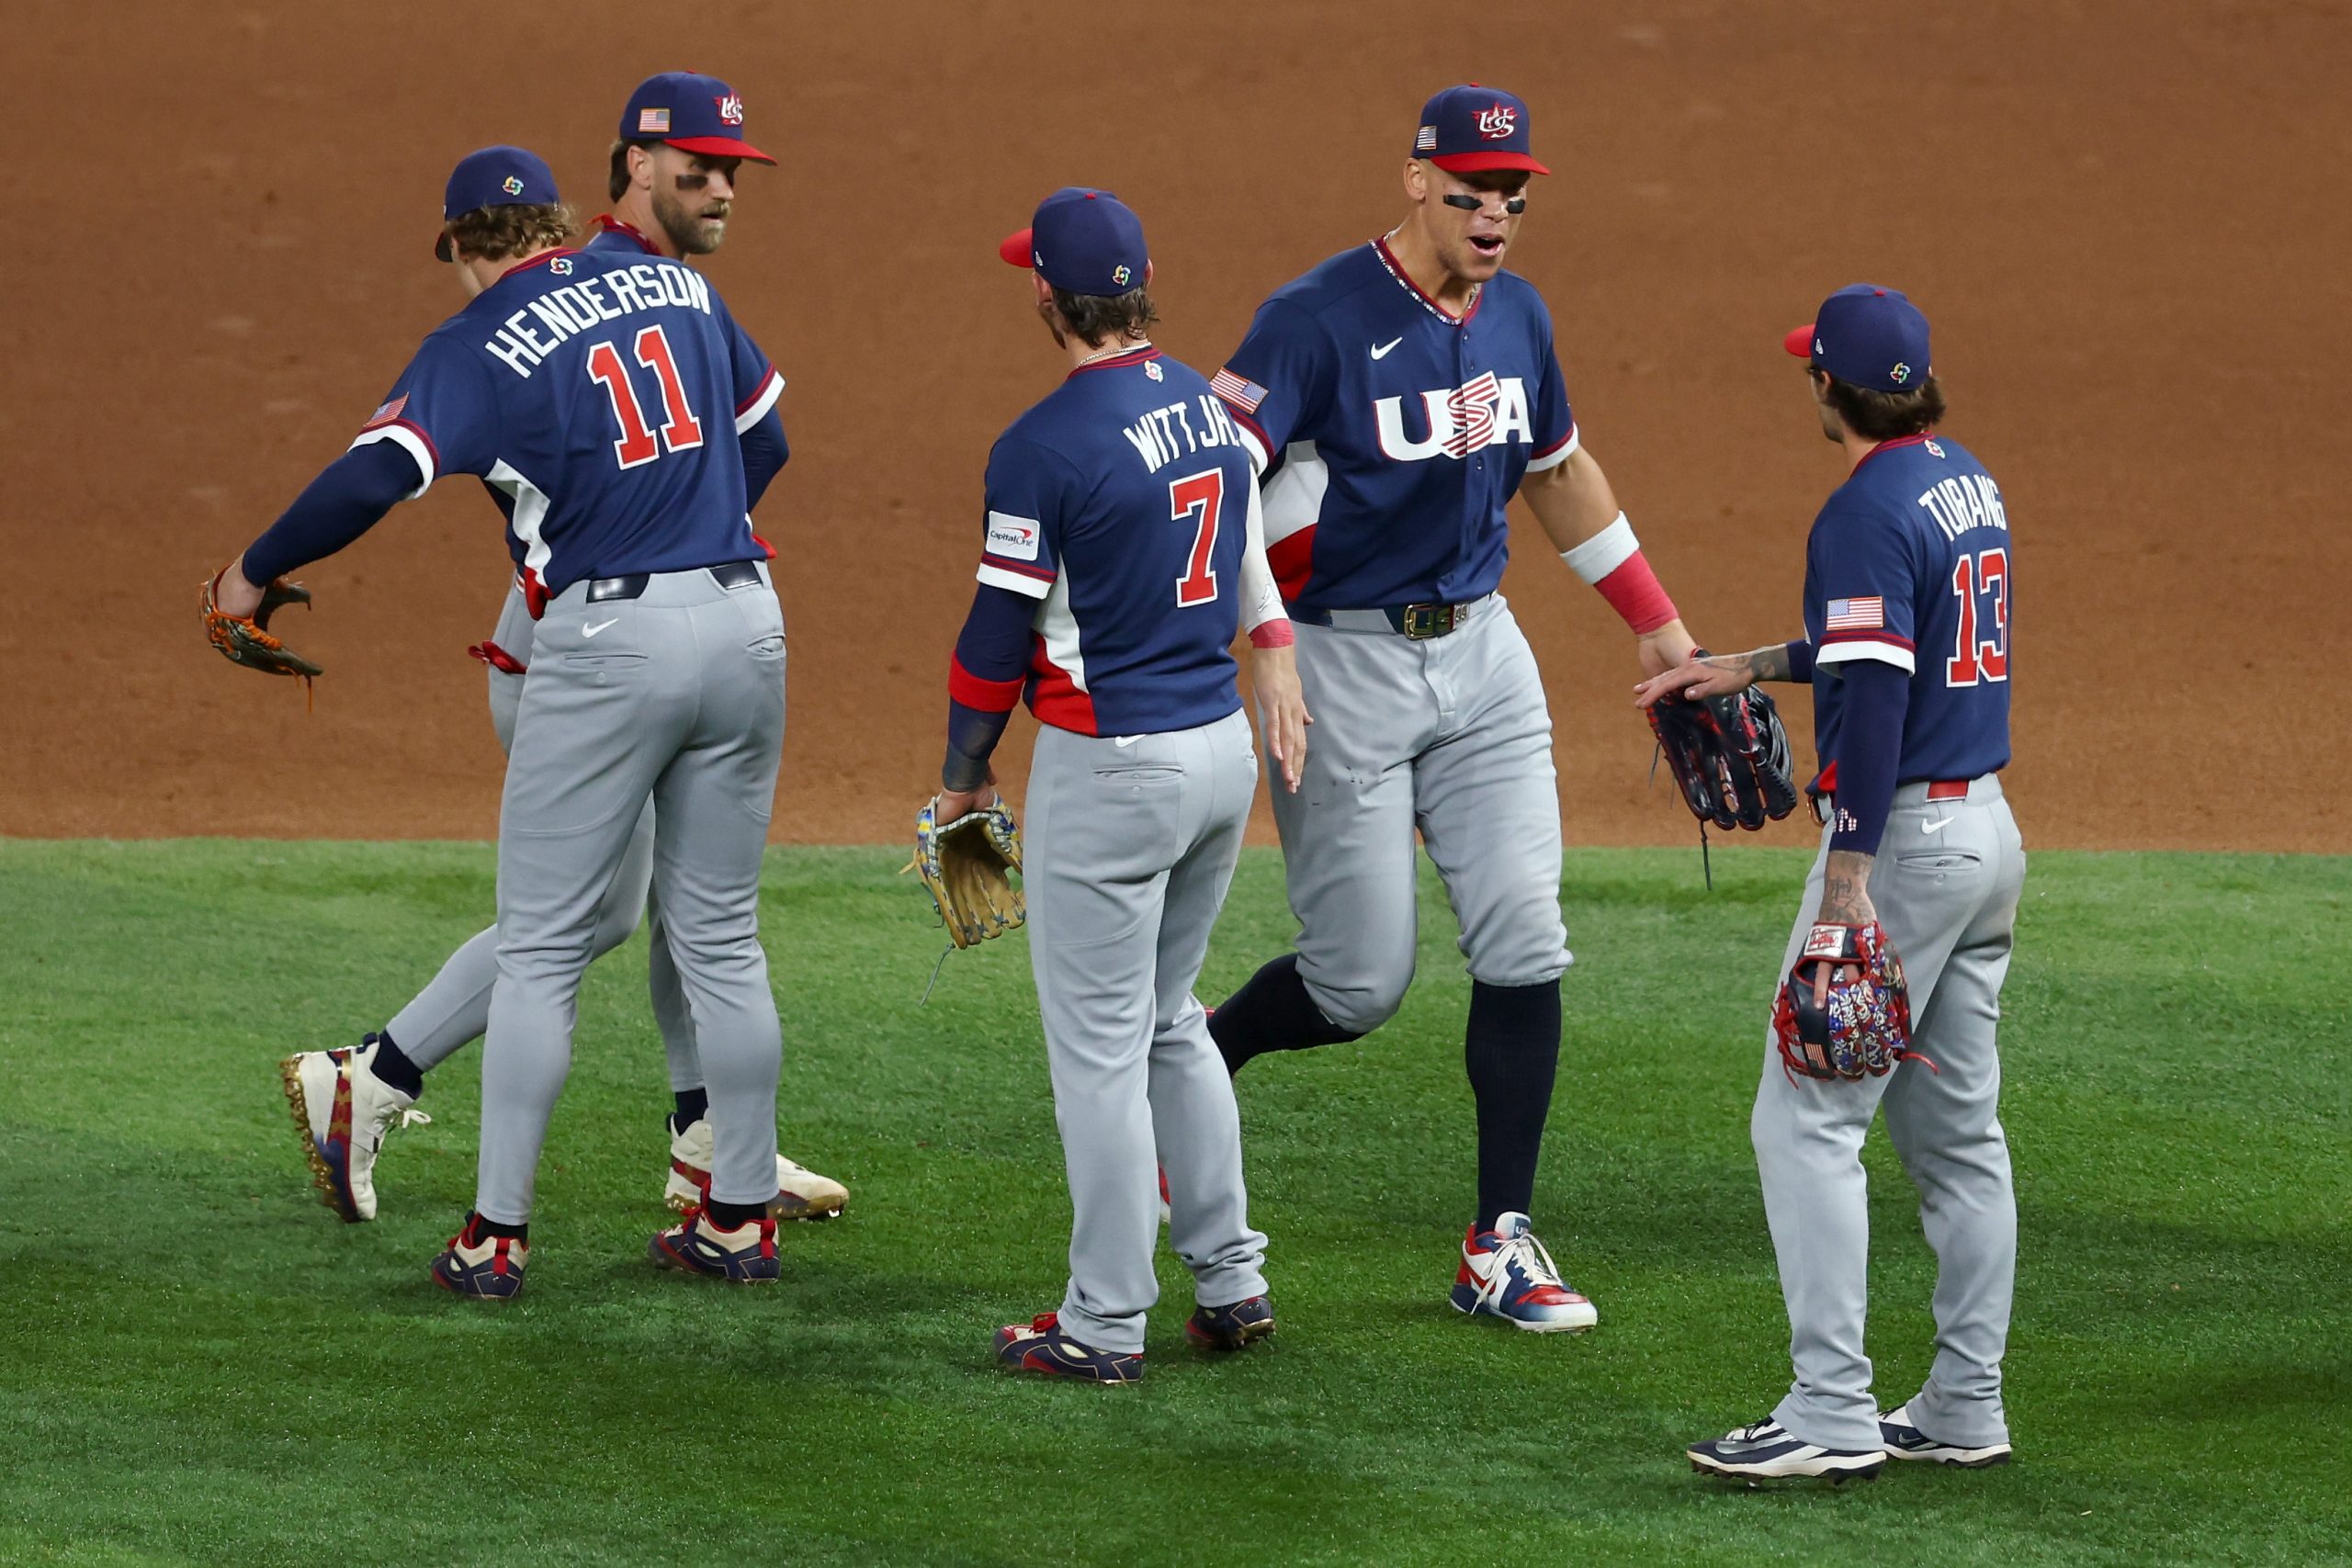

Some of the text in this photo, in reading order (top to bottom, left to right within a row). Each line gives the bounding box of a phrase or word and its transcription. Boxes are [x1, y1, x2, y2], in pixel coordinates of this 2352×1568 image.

[484, 263, 712, 379] HENDERSON
[586, 323, 704, 470] 11
[1123, 401, 1197, 474] WITT
[1374, 370, 1533, 461] USA
[1169, 467, 1225, 608] 7
[1917, 474, 2007, 542] TURANG
[1946, 547, 2007, 688] 13
